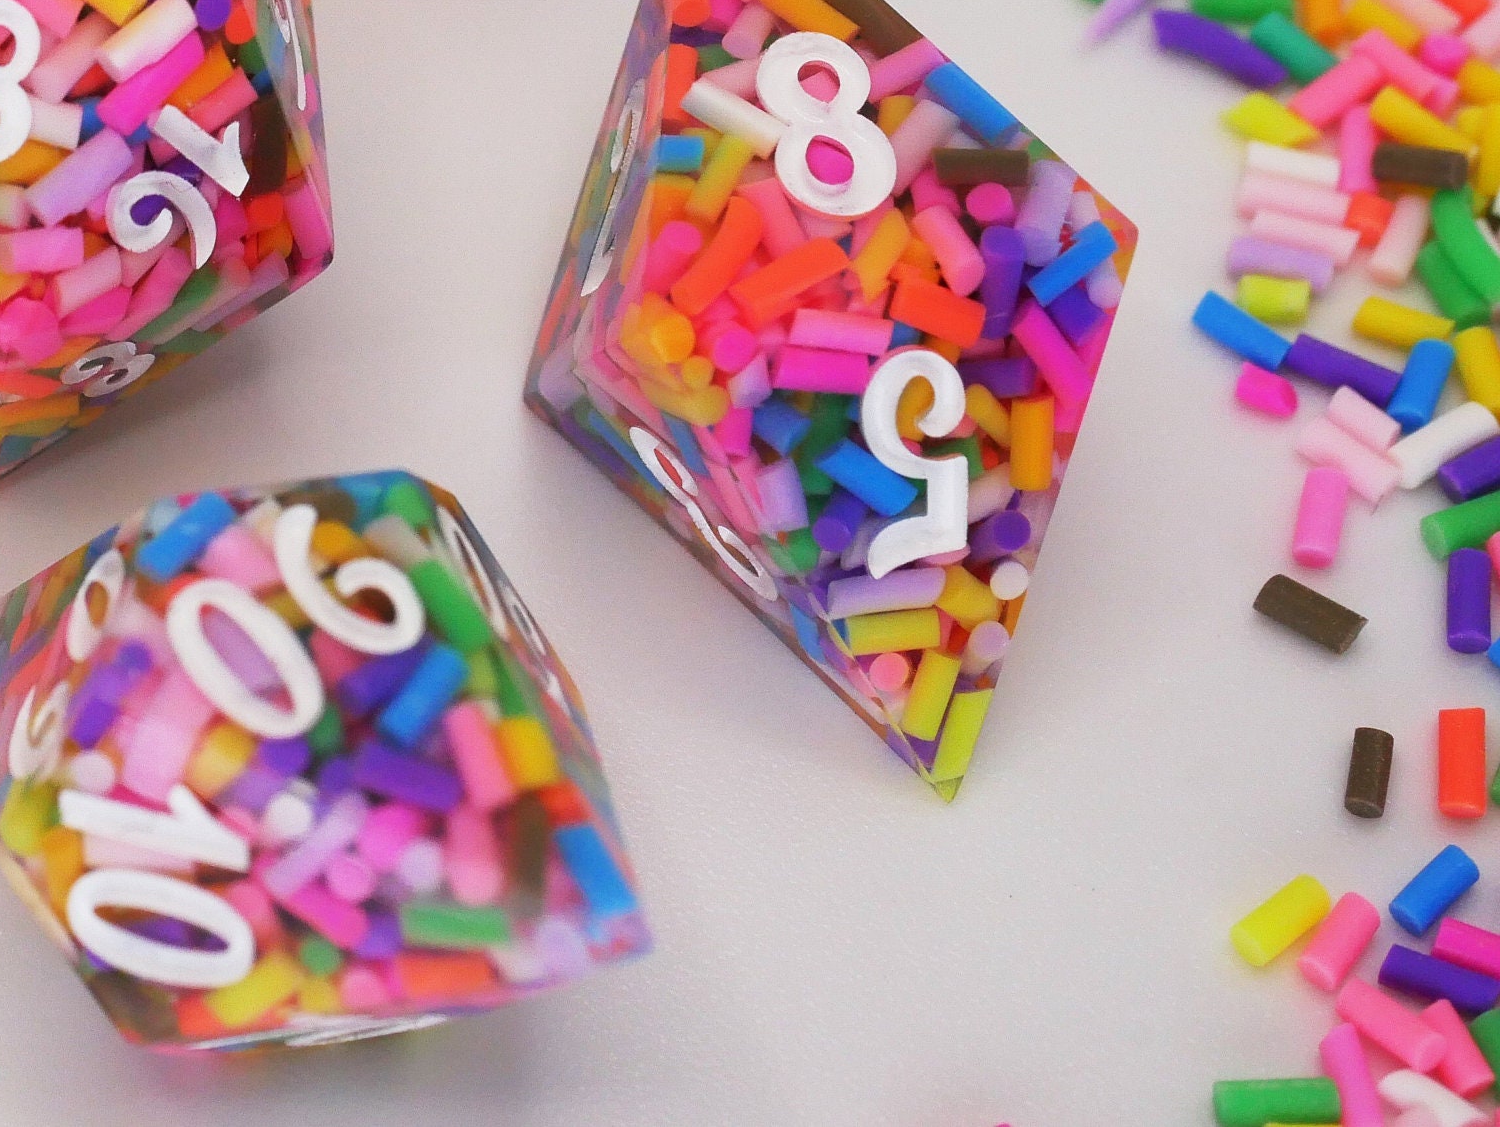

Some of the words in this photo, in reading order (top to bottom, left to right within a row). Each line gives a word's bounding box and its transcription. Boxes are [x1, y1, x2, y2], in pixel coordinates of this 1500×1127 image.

[107, 104, 250, 269] 16
[756, 31, 897, 217] 8
[862, 349, 968, 579] 5
[59, 784, 255, 988] 10
